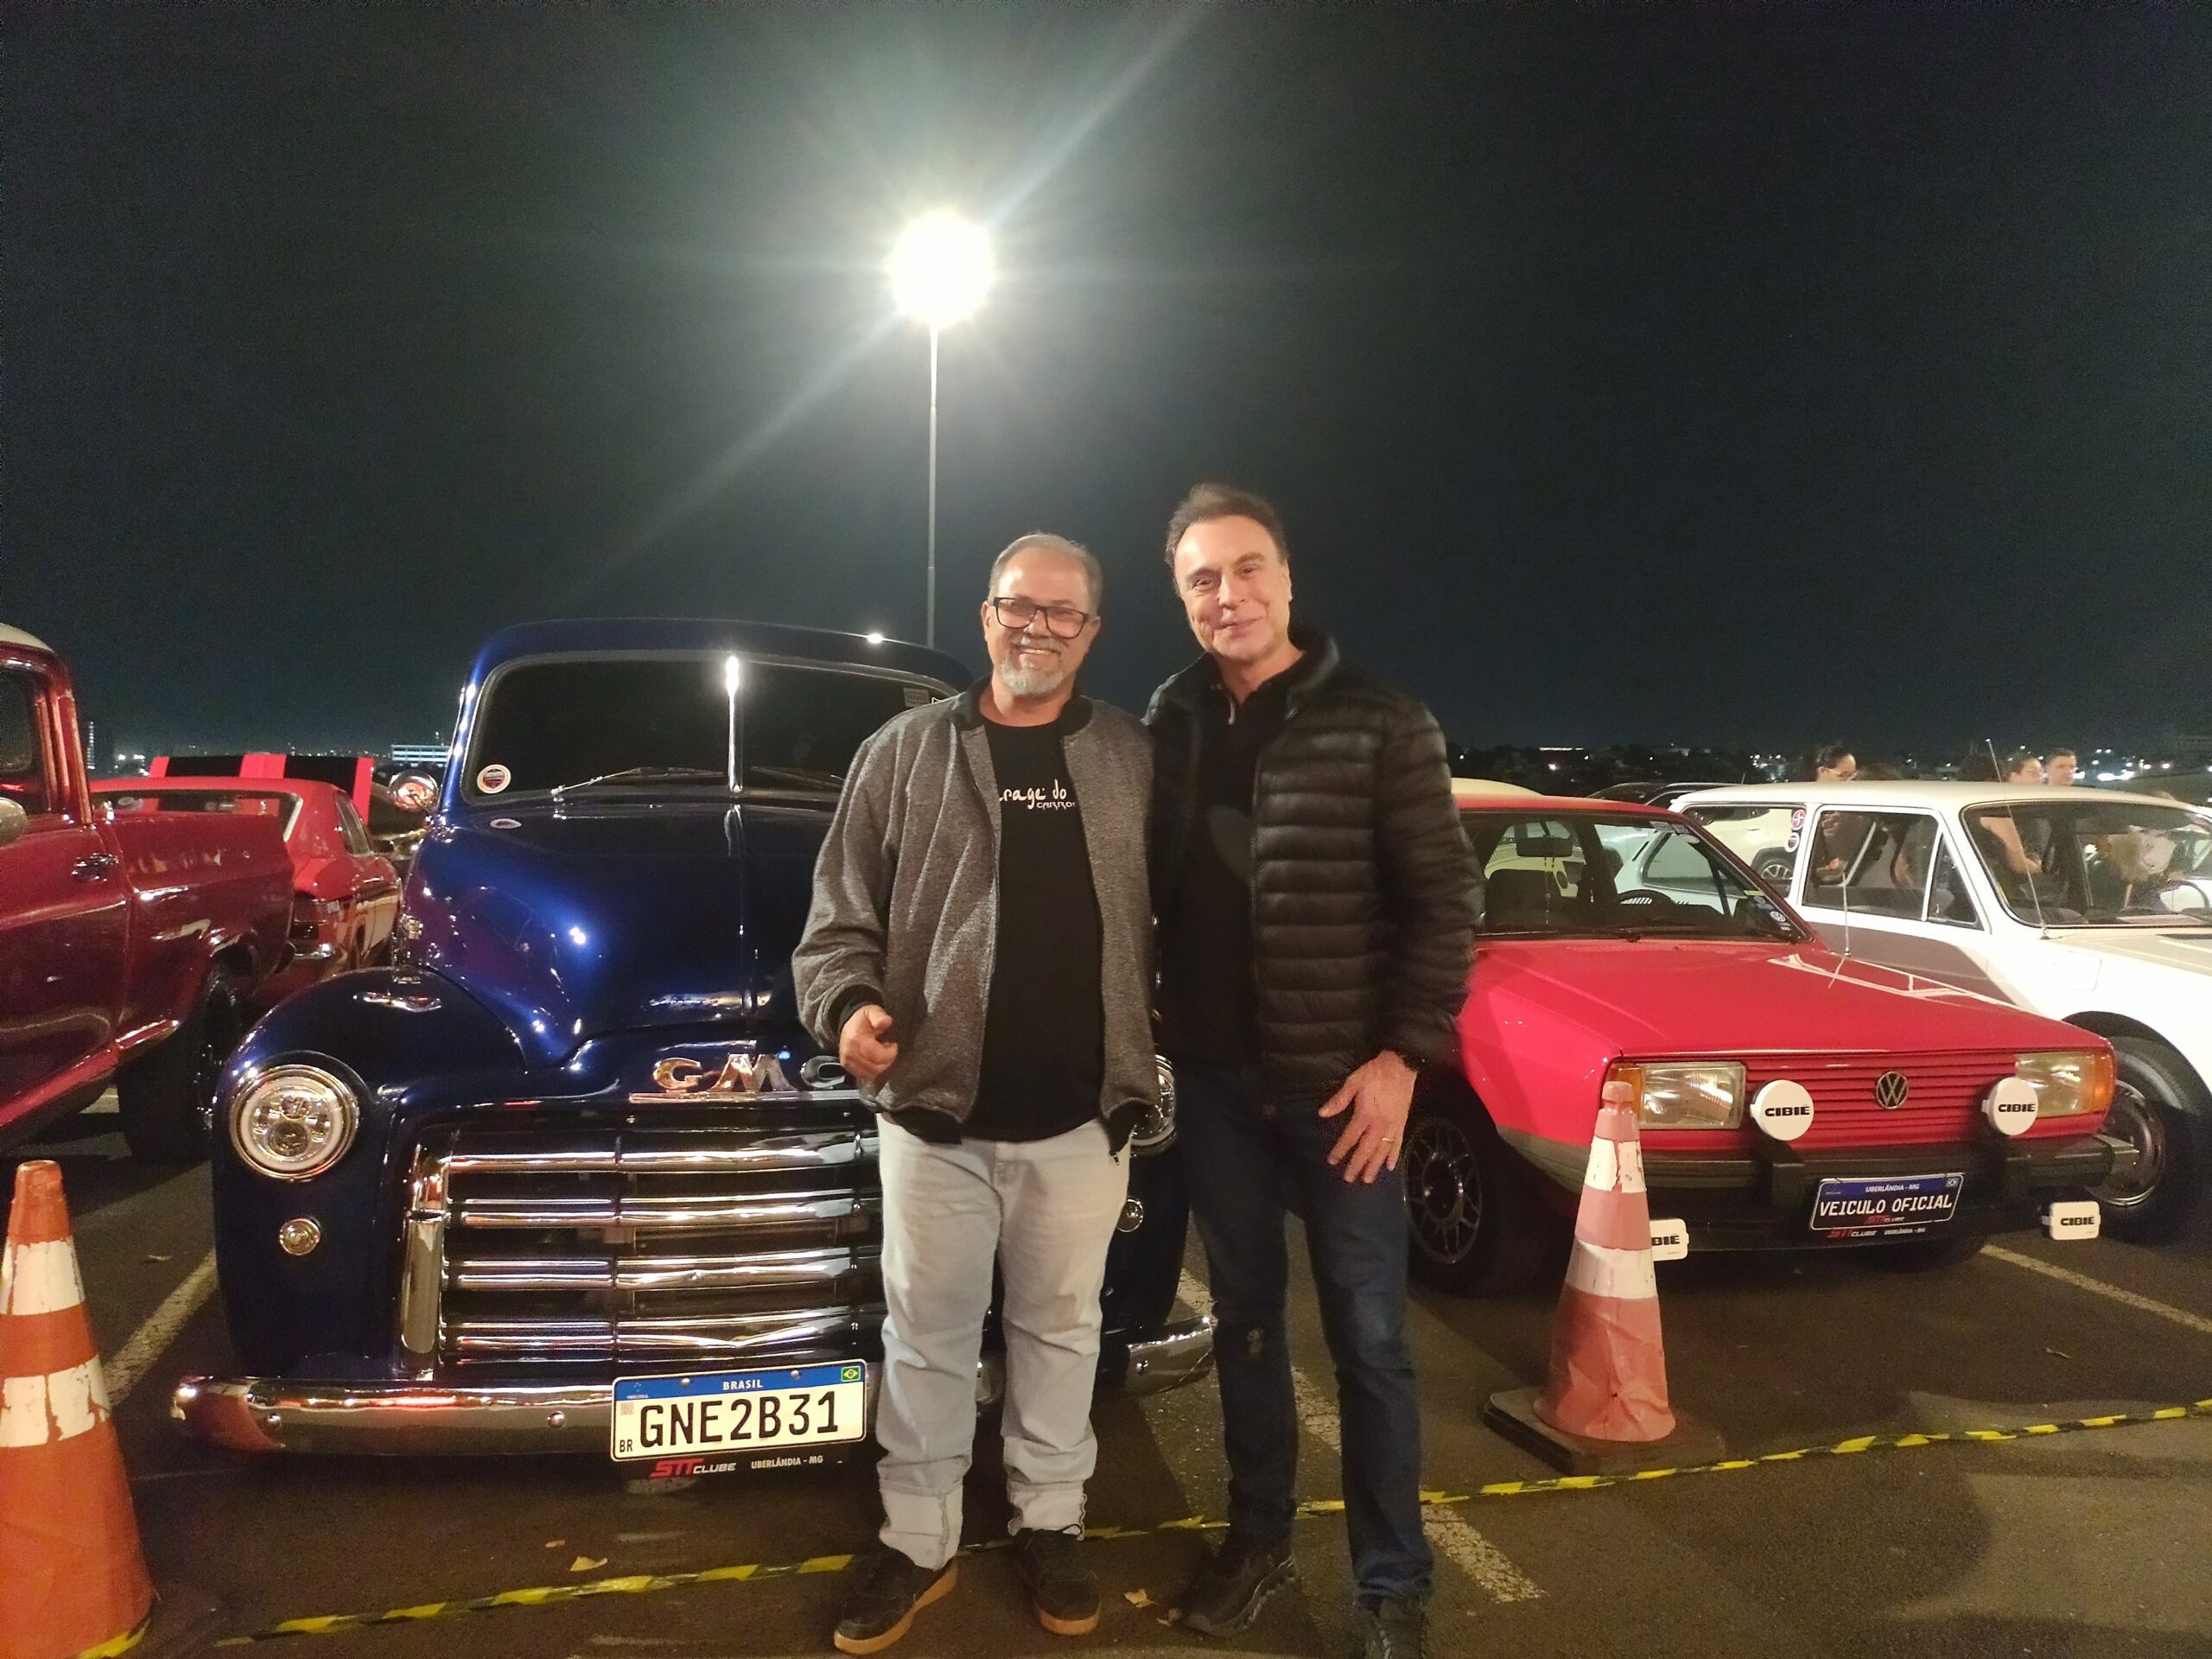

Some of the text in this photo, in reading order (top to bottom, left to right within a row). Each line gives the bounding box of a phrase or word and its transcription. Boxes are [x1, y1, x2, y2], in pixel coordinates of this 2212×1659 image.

[999, 779, 1067, 810] rage do
[652, 1053, 847, 1092] GMC
[1820, 1194, 1953, 1217] VEICULO OFICIAL
[1650, 1235, 1681, 1246] BIE
[722, 1379, 763, 1391] BRASIL
[639, 1390, 839, 1448] GNE2B31
[619, 1439, 633, 1452] BR
[809, 1455, 823, 1465] MG
